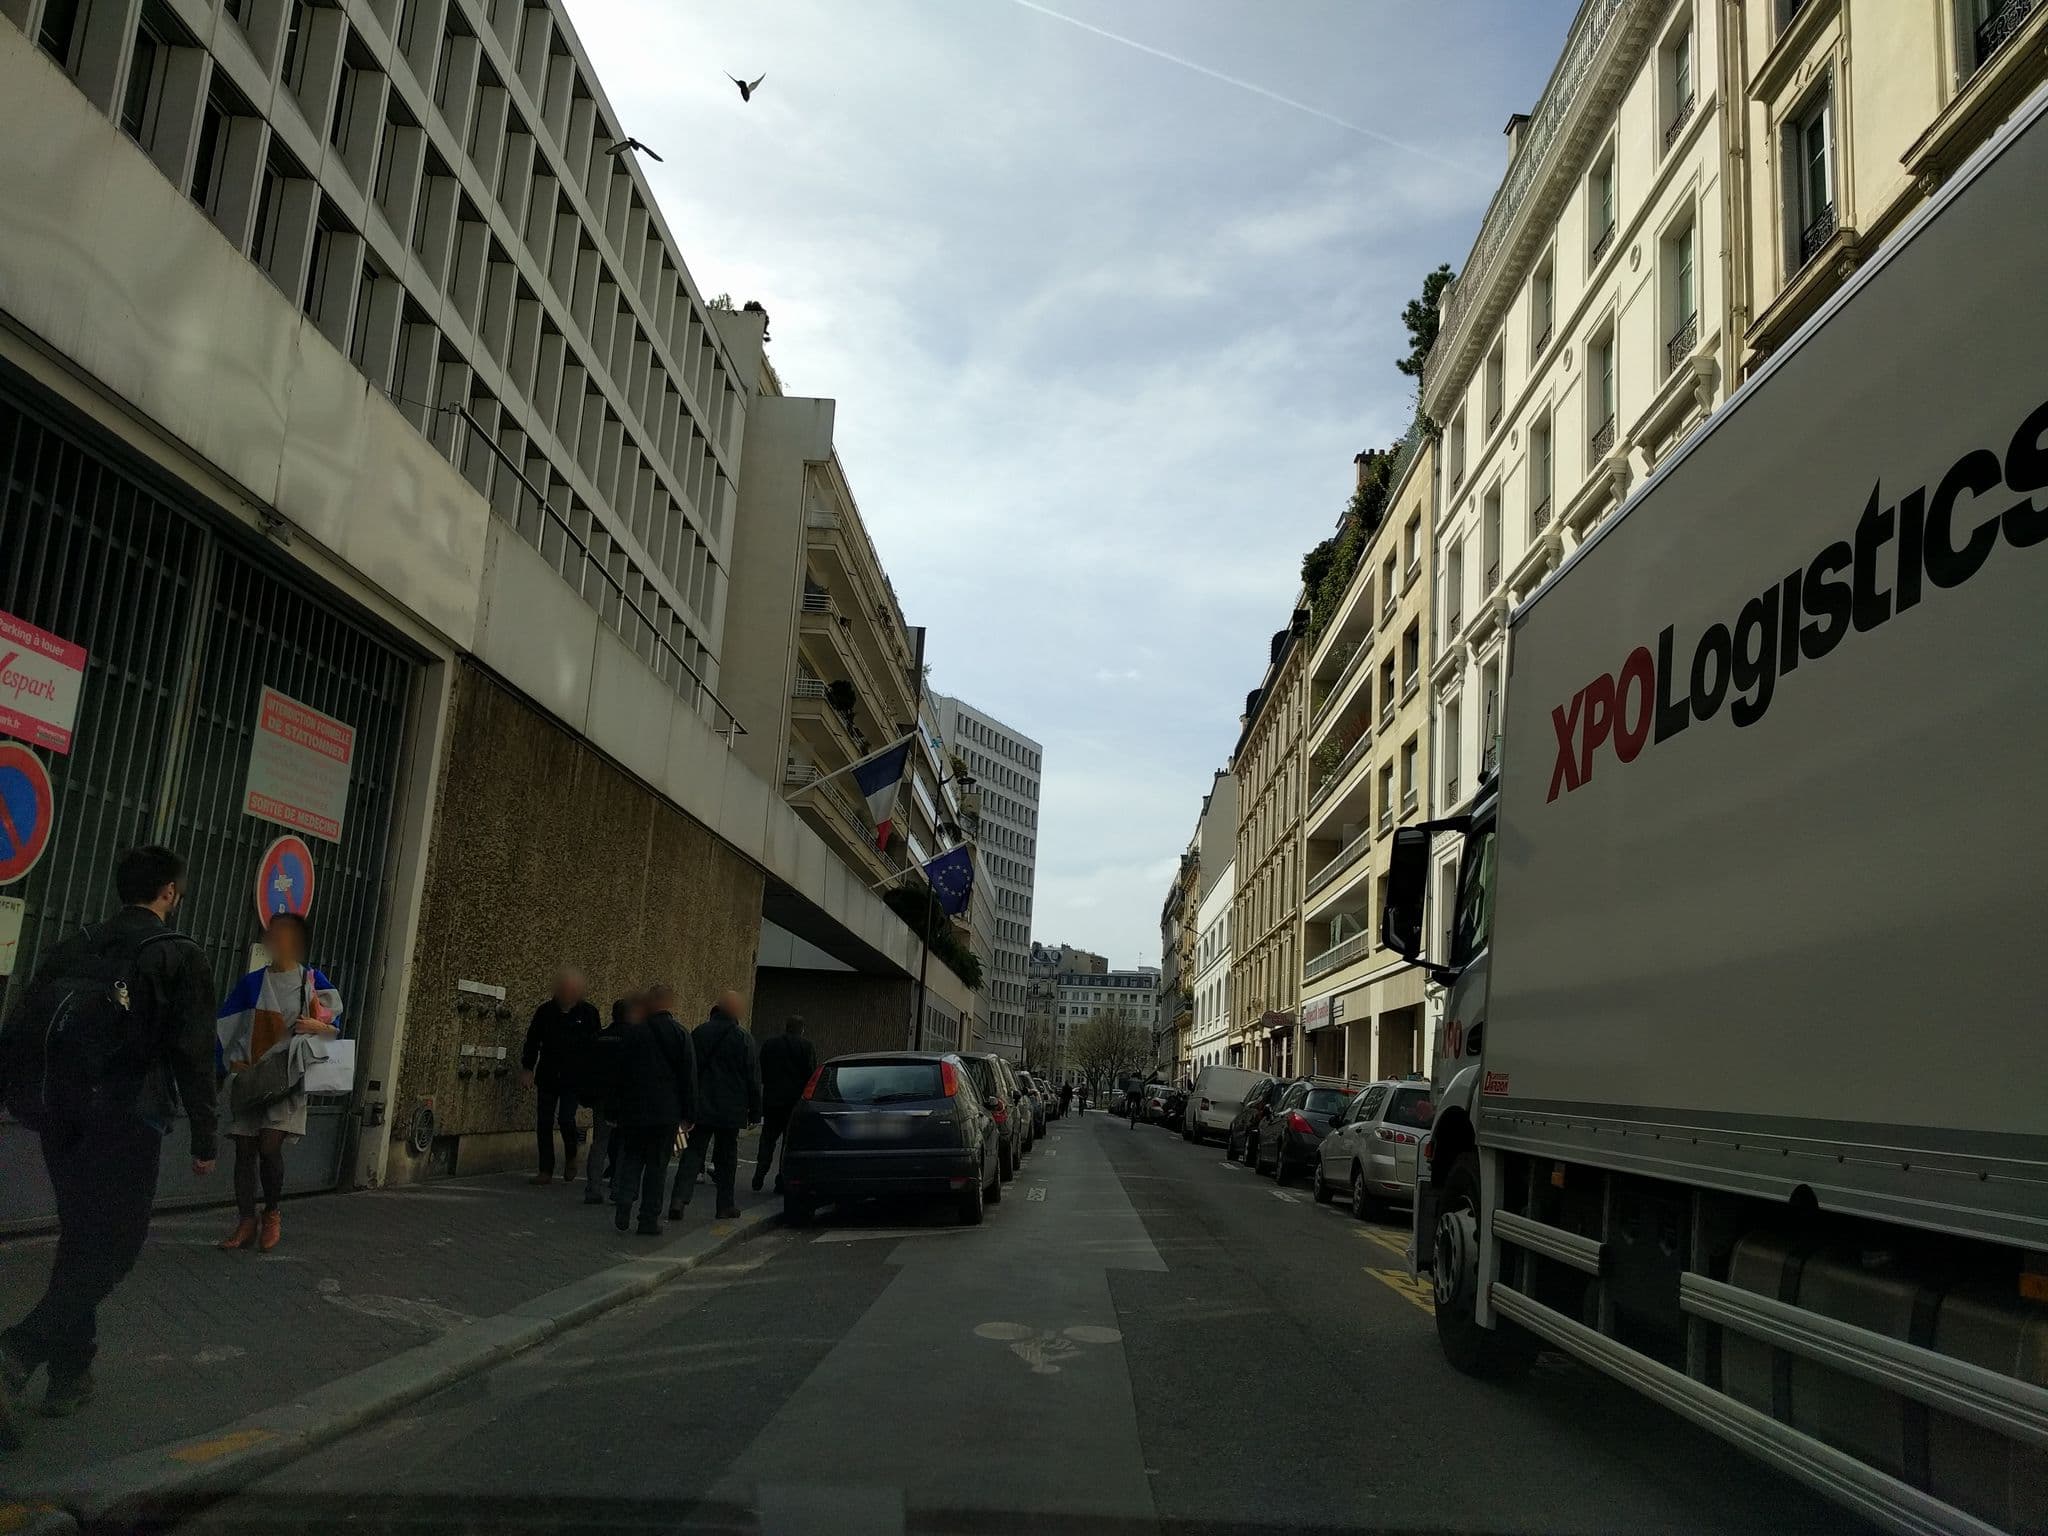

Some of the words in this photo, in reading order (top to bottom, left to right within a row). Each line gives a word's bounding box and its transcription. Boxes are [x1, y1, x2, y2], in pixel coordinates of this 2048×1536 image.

[41, 637, 65, 656] louer
[268, 716, 282, 732] DE
[284, 724, 344, 760] STATIONNER
[250, 795, 283, 817] SORTIE
[284, 806, 297, 822] DE
